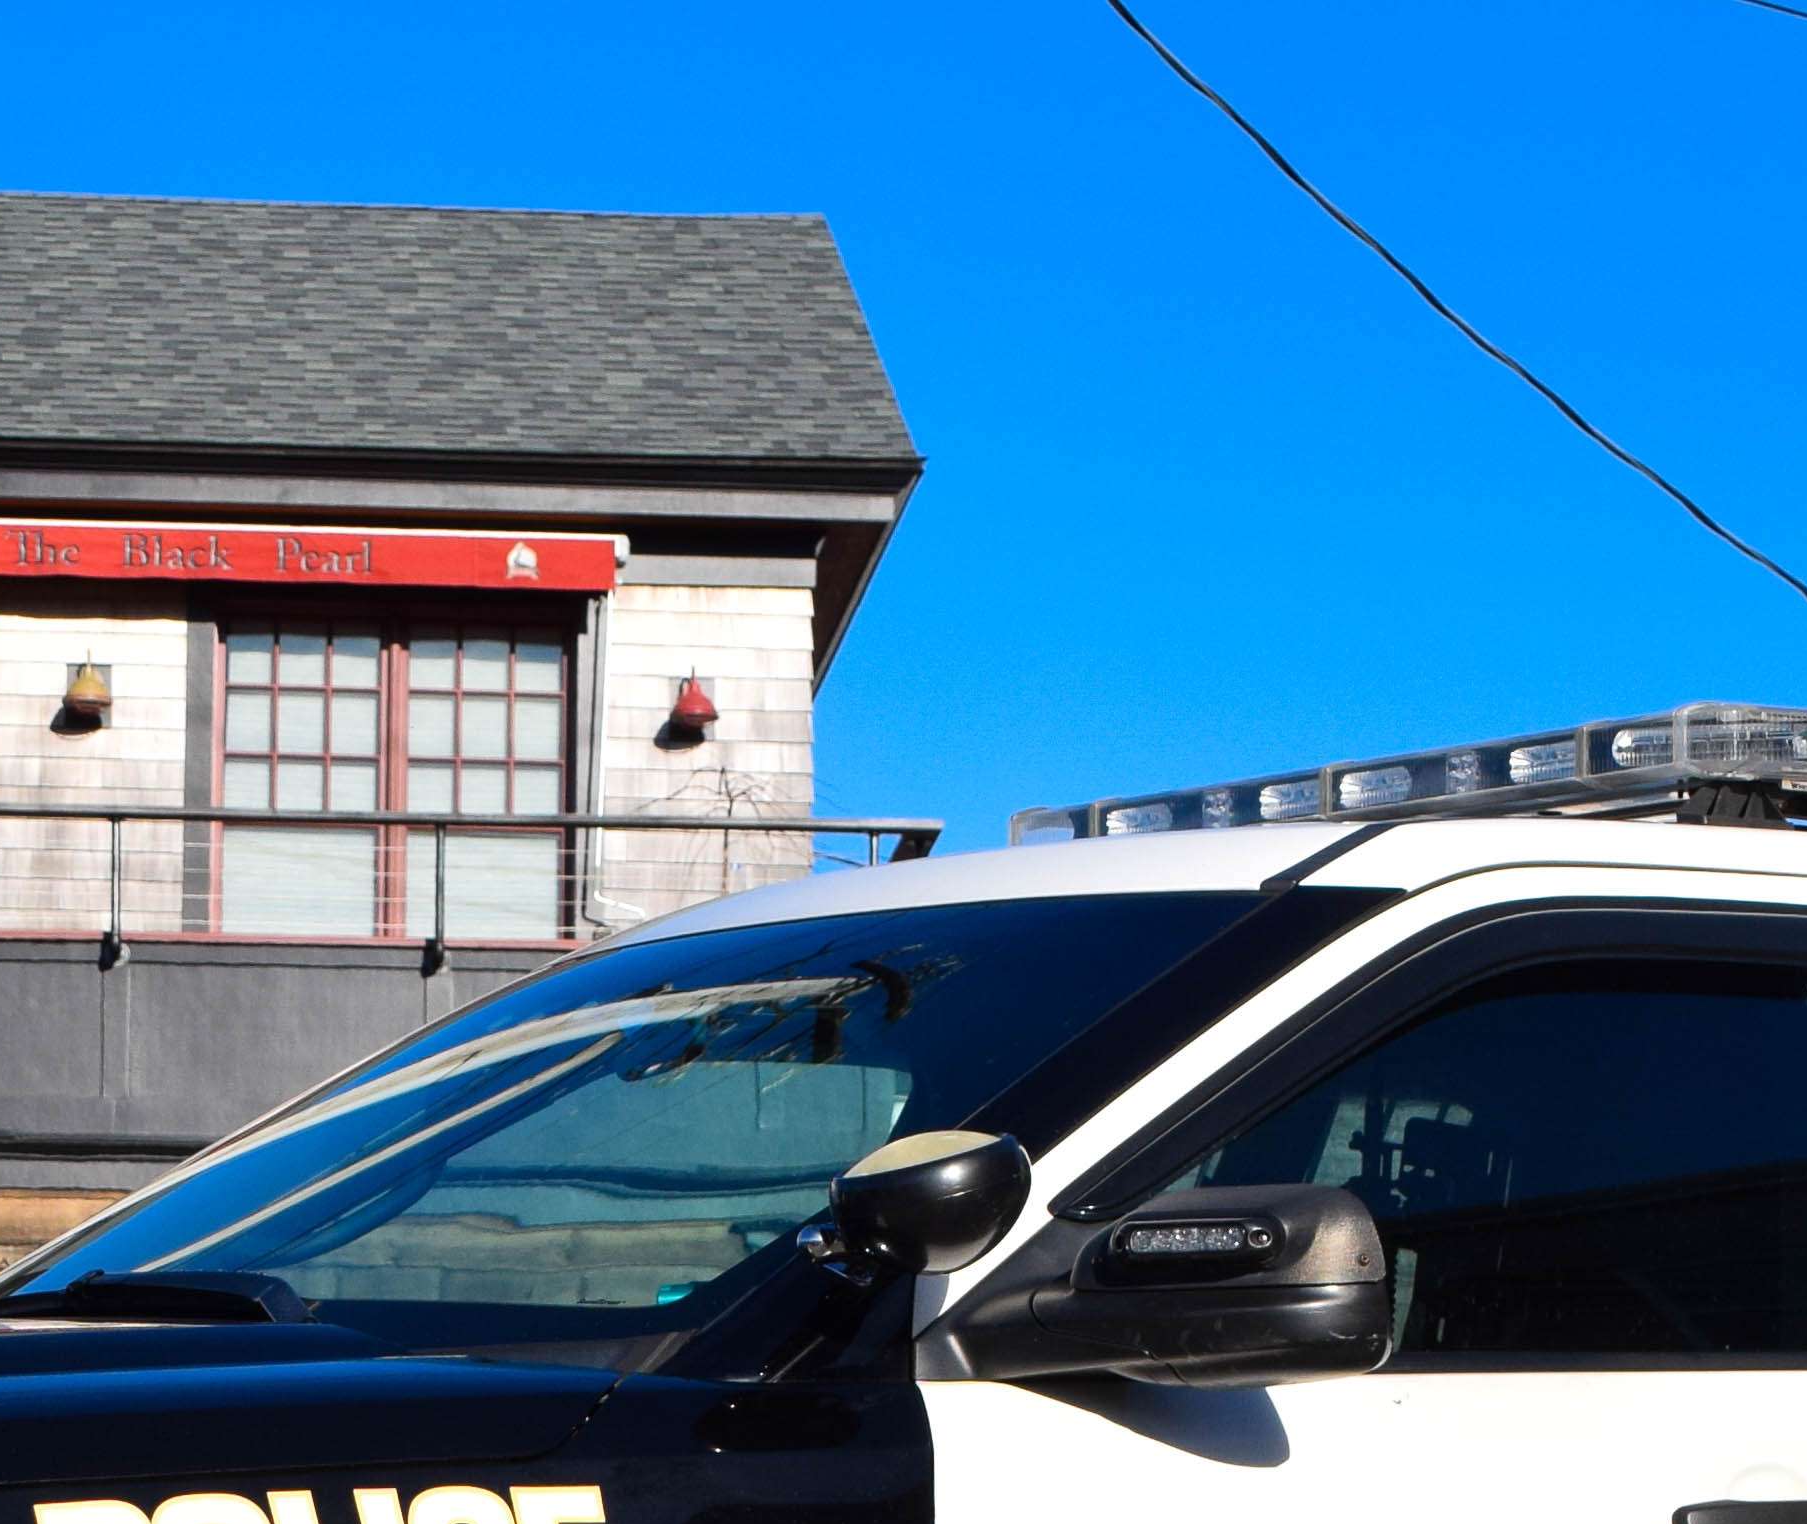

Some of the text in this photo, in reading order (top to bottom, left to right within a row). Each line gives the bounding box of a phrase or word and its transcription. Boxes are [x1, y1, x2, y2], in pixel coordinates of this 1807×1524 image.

[5, 530, 373, 575] The Black Pearl
